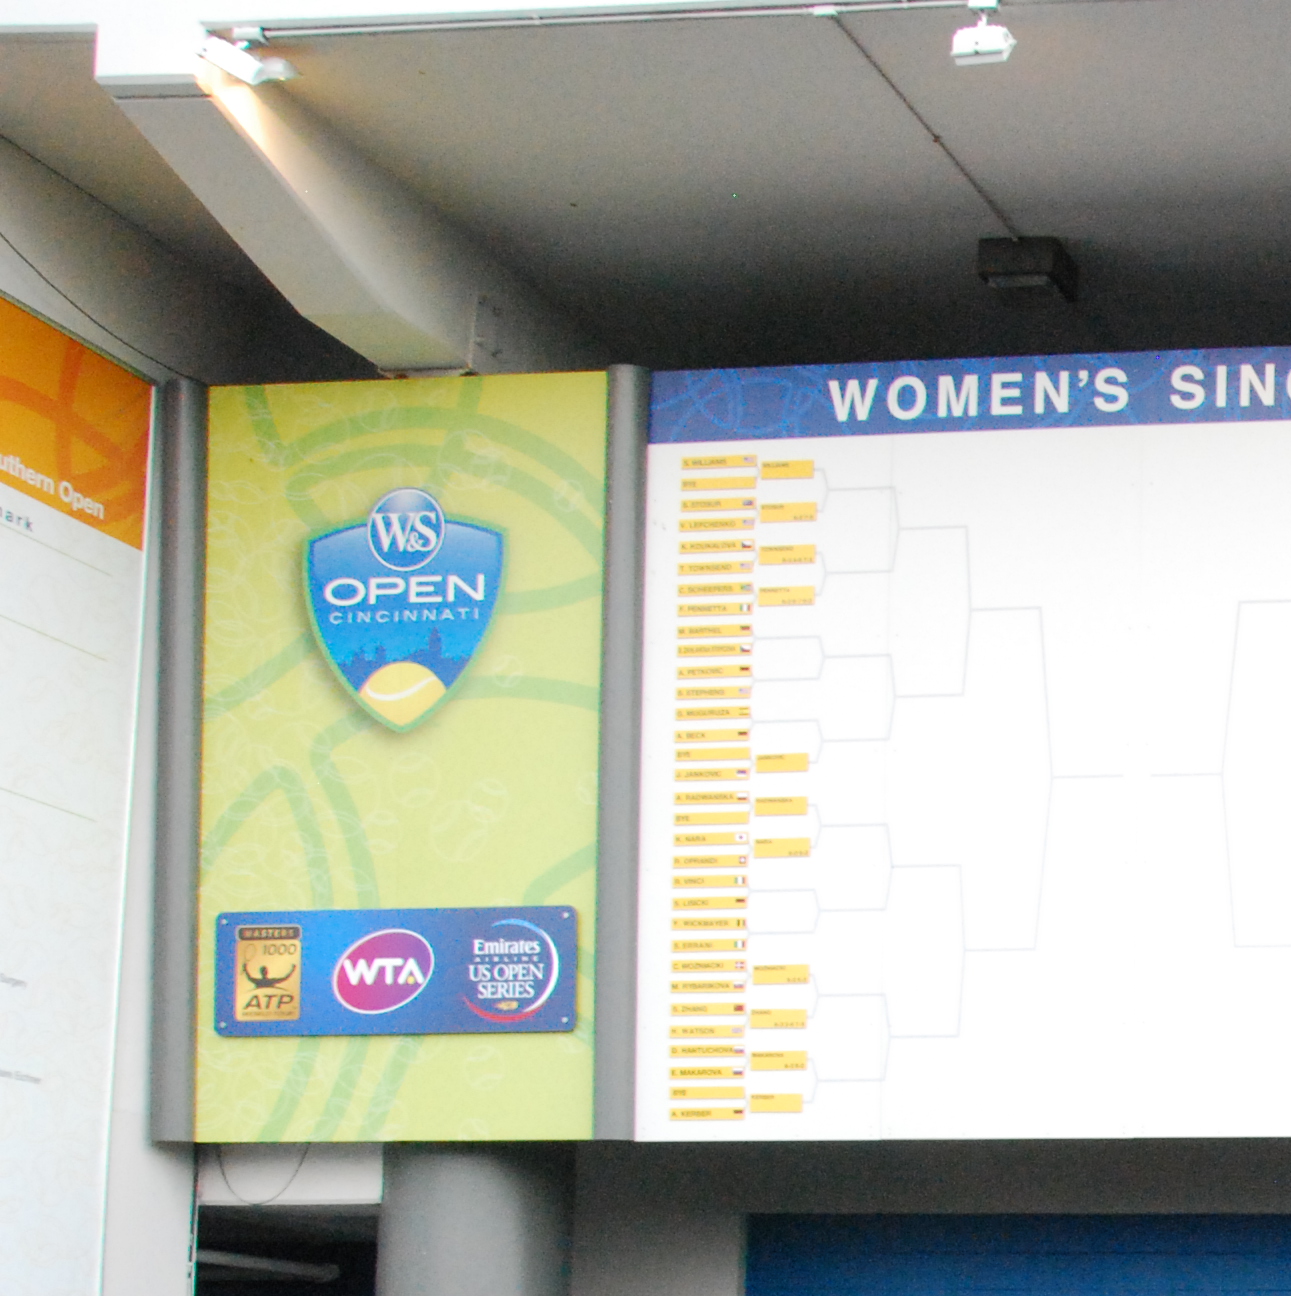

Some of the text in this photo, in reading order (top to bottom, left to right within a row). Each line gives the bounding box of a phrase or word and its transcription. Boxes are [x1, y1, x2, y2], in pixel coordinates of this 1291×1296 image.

[828, 366, 1128, 424] WOMEN'S
[58, 480, 105, 520] Open
[373, 512, 437, 552] W&S
[324, 574, 485, 606] OPEN
[329, 608, 479, 625] CINCINNATI
[263, 944, 296, 955] 1000
[473, 938, 540, 954] Emirates
[343, 958, 424, 985] WTA
[469, 964, 544, 981] US OPEN
[477, 981, 535, 999] SERIES
[244, 995, 294, 1009] ATP
